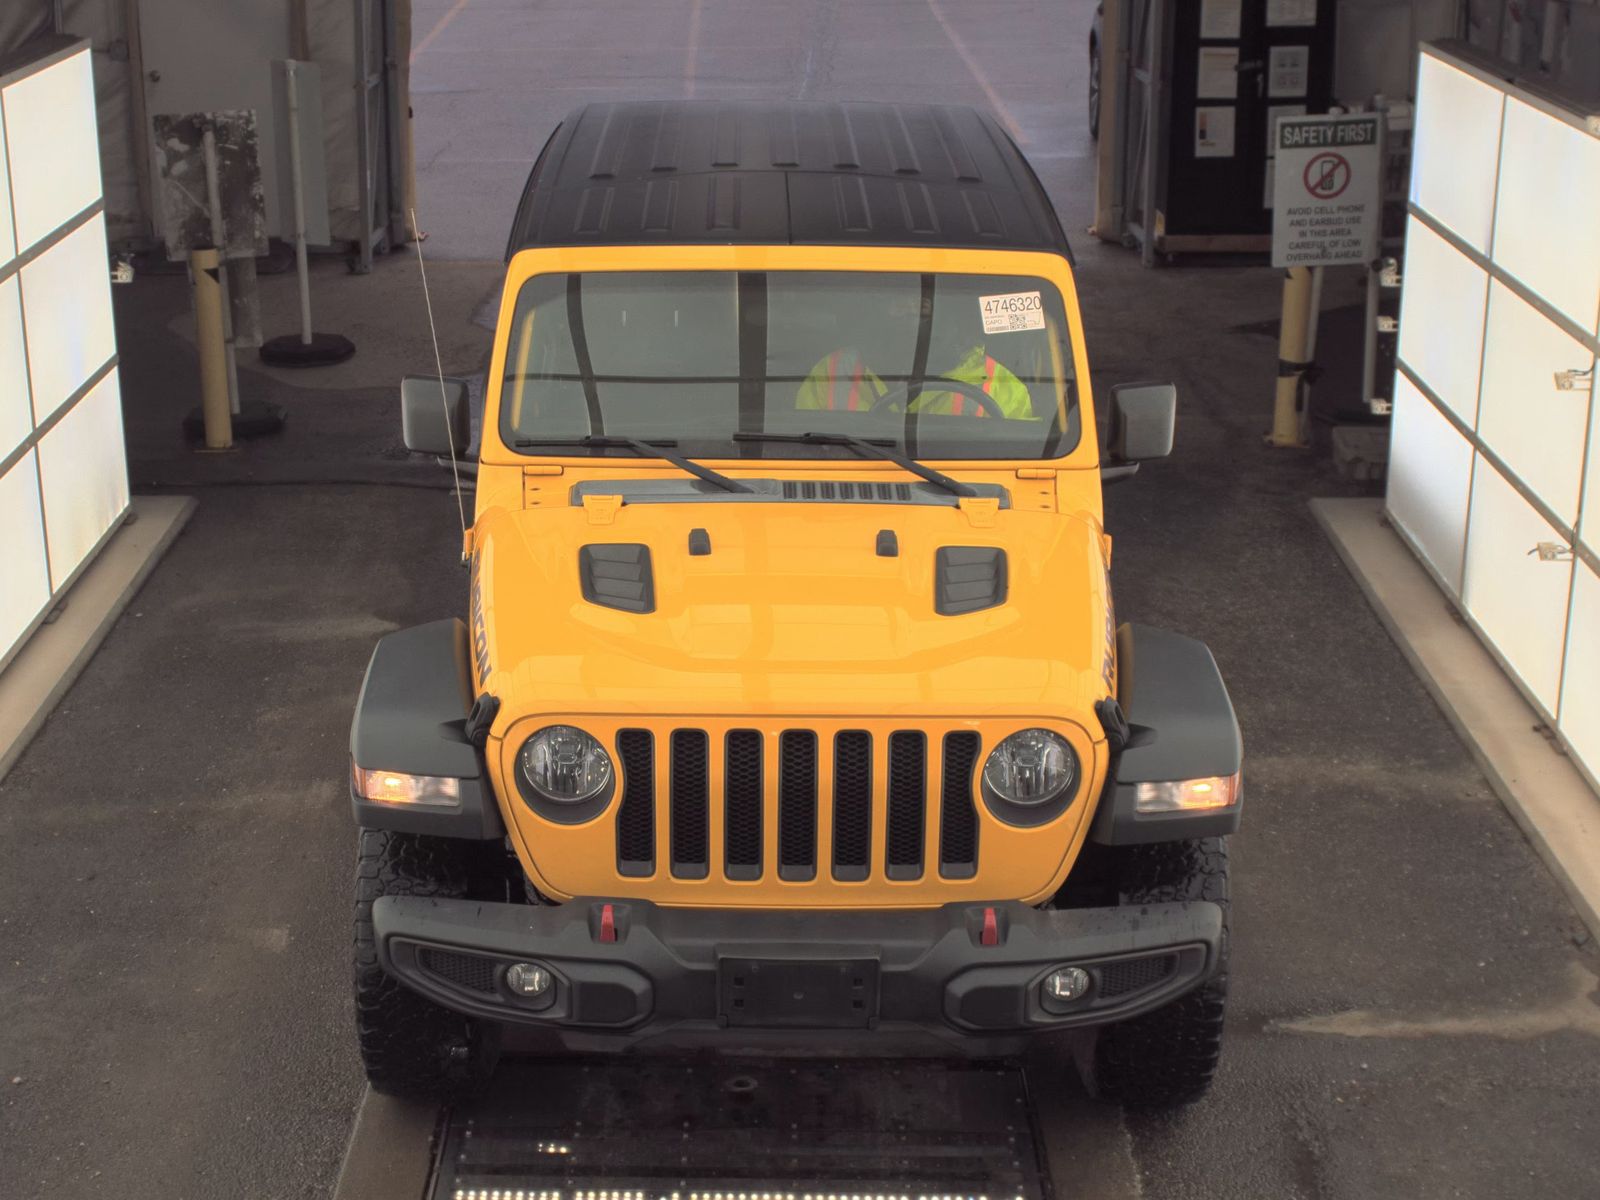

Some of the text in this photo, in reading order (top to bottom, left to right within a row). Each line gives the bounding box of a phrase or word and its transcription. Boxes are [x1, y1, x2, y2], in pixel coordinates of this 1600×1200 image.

[1283, 124, 1373, 145] SAFETY FIRST
[1286, 204, 1365, 216] AVOID CELL PHONE
[1289, 216, 1362, 227] AND EARBUD USE
[1298, 228, 1352, 238] IN THIS AREA
[1288, 239, 1361, 250] CAREFUL OF LOW
[1334, 250, 1361, 259] AHEAD
[985, 296, 1042, 314] 4746320
